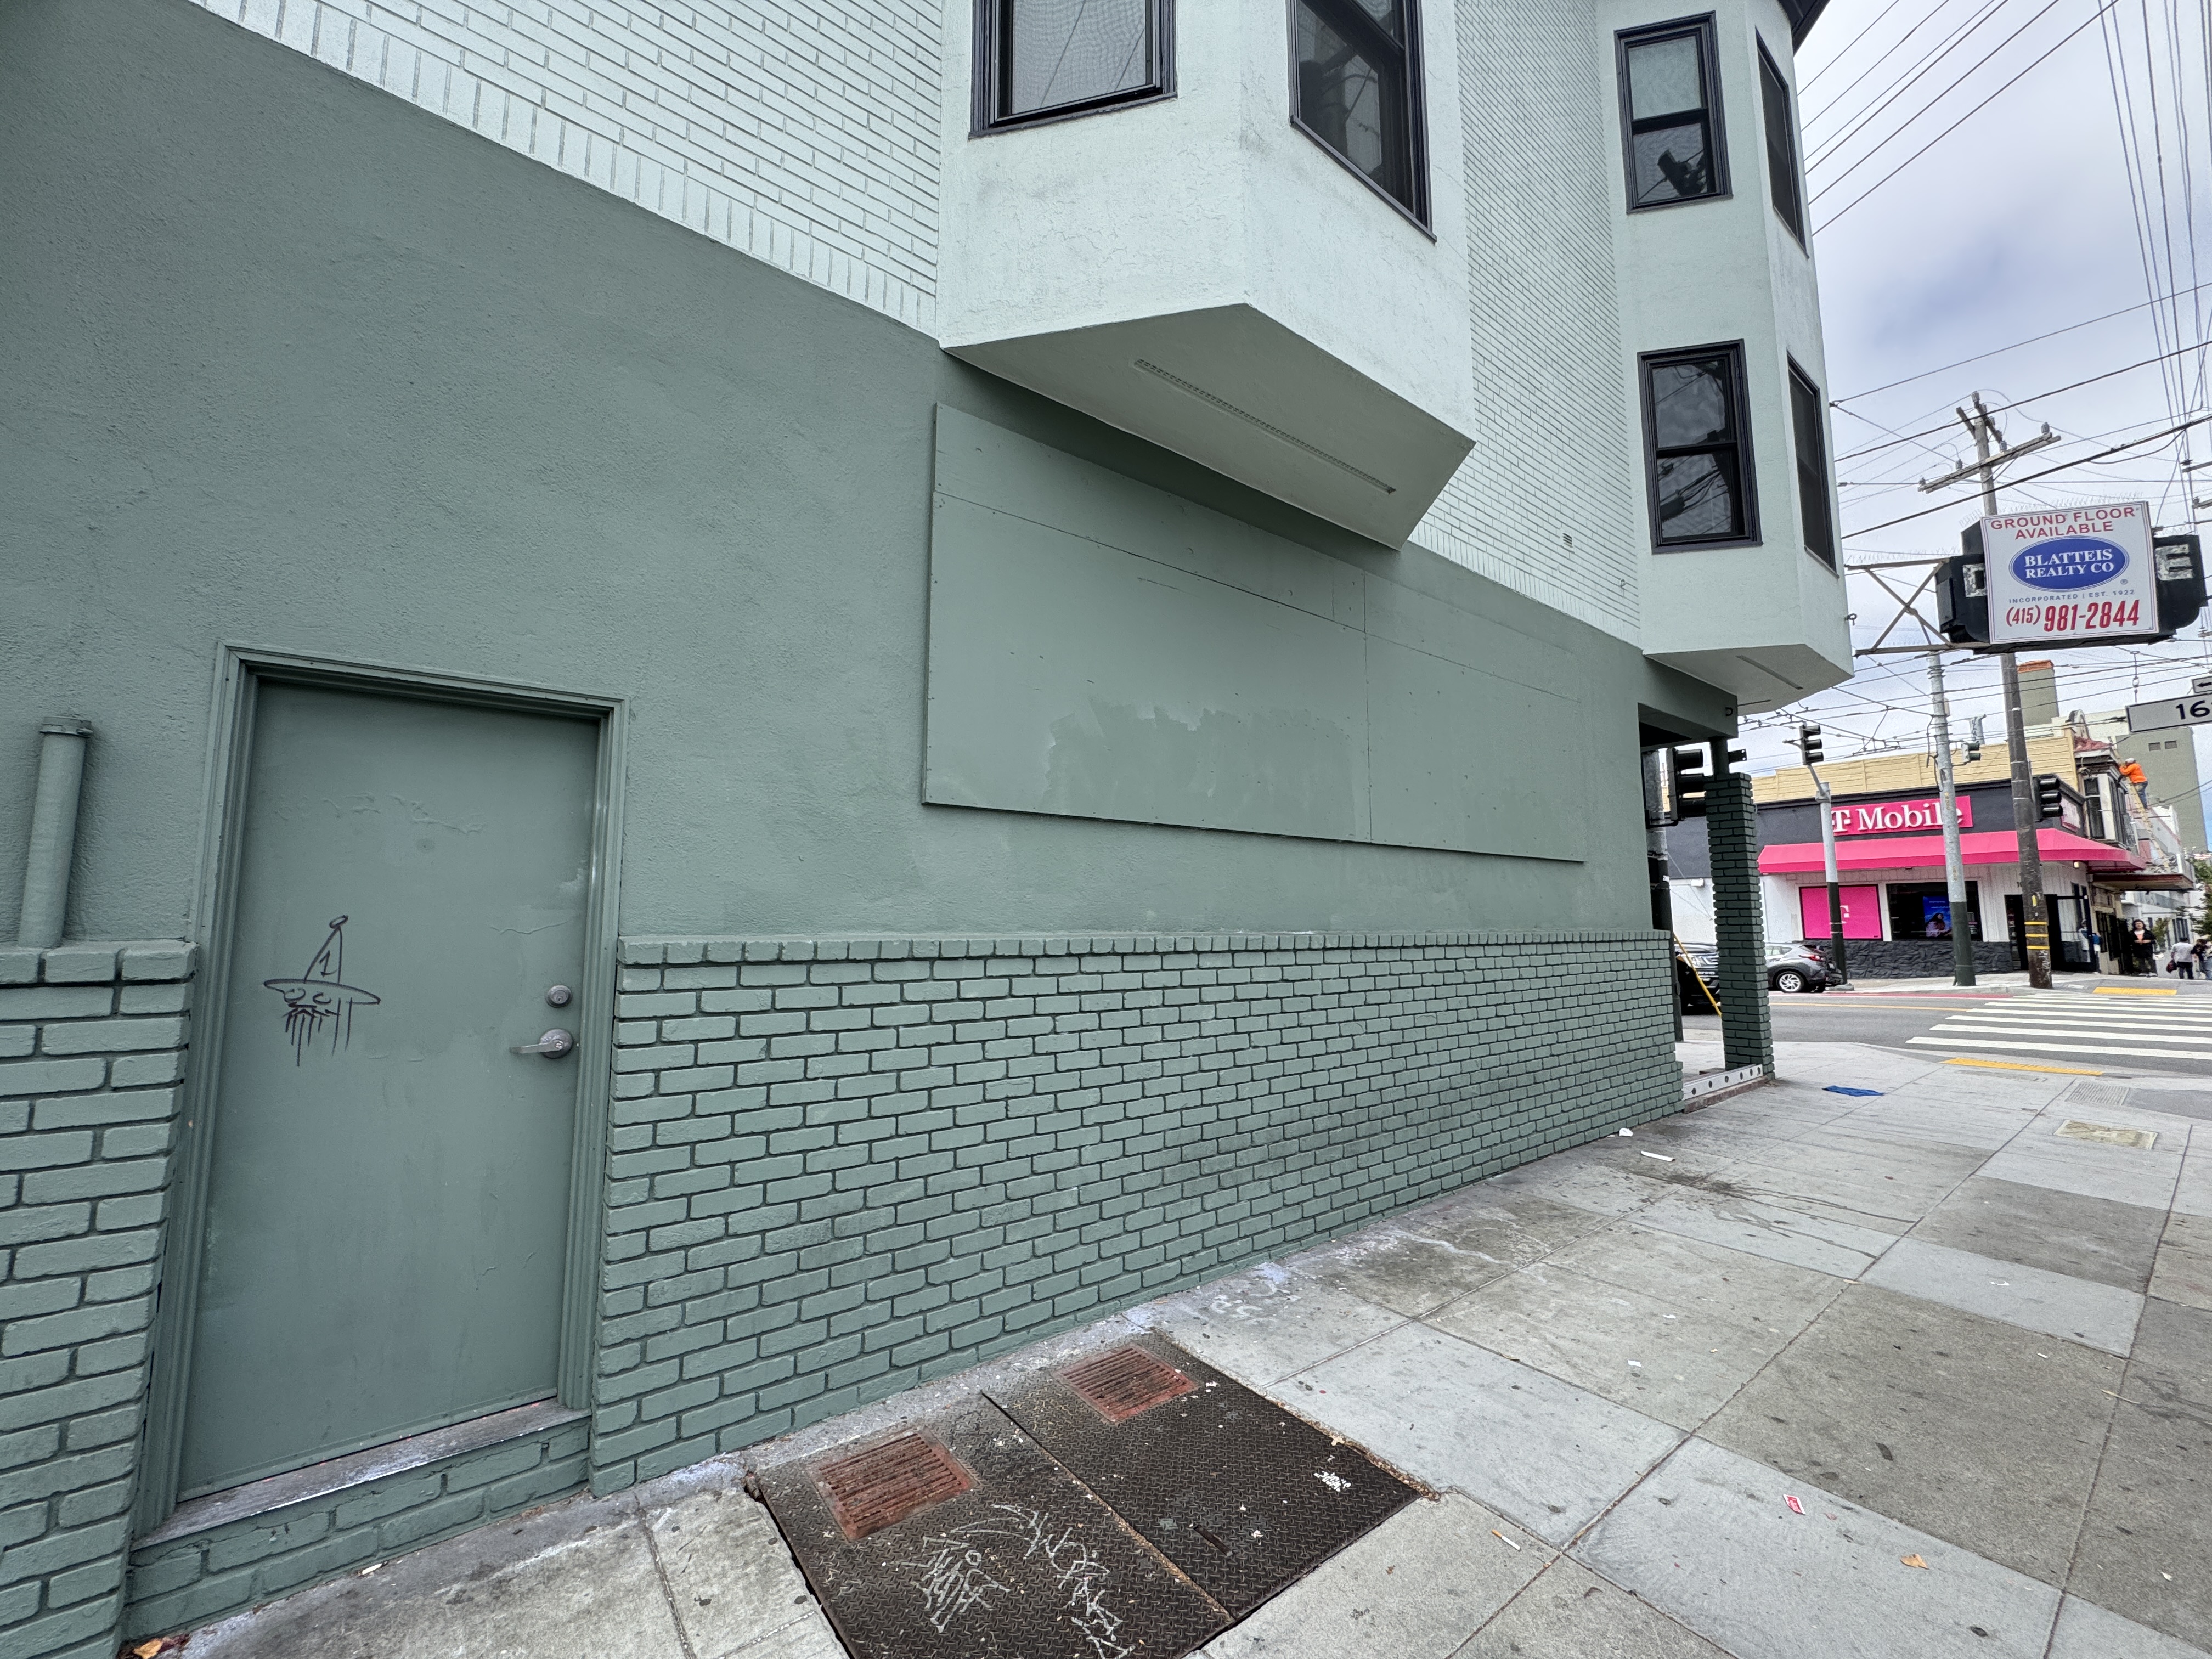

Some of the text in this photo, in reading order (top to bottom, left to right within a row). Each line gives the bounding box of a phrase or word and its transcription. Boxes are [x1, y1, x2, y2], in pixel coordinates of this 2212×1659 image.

[1990, 507, 2135, 530] GROUND FLOOR
[2015, 521, 2114, 540] AVAILABLE
[2024, 549, 2113, 567] BLATTEIS
[2025, 562, 2114, 579] REALTY CO
[2008, 594, 2078, 604] INCORPORATED
[2006, 599, 2140, 632] (415) 981-2844
[2175, 700, 2212, 720] 16
